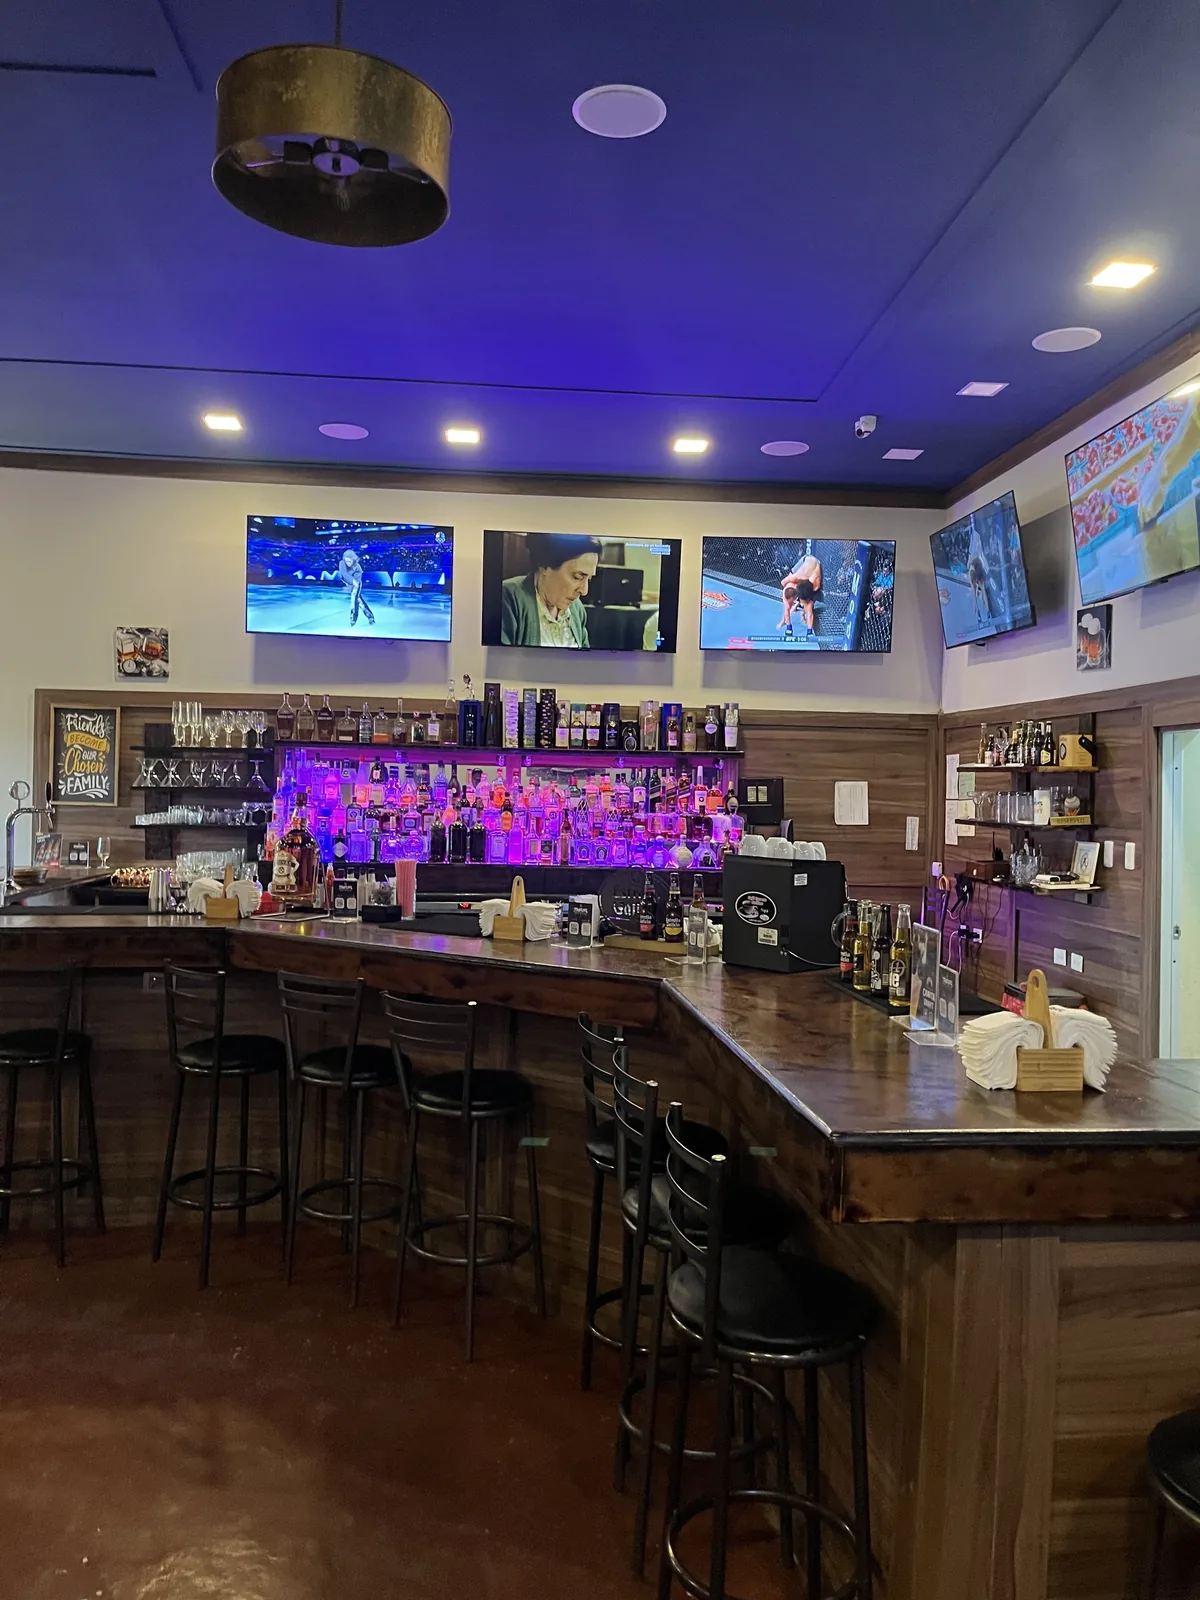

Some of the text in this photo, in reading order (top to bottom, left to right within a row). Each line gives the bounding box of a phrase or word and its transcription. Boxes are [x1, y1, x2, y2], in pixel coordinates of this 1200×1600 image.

[66, 713, 105, 738] Friends
[70, 734, 104, 748] BECOME
[65, 748, 104, 775] Chosen
[82, 751, 97, 761] OUR
[67, 775, 108, 792] FAMILY
